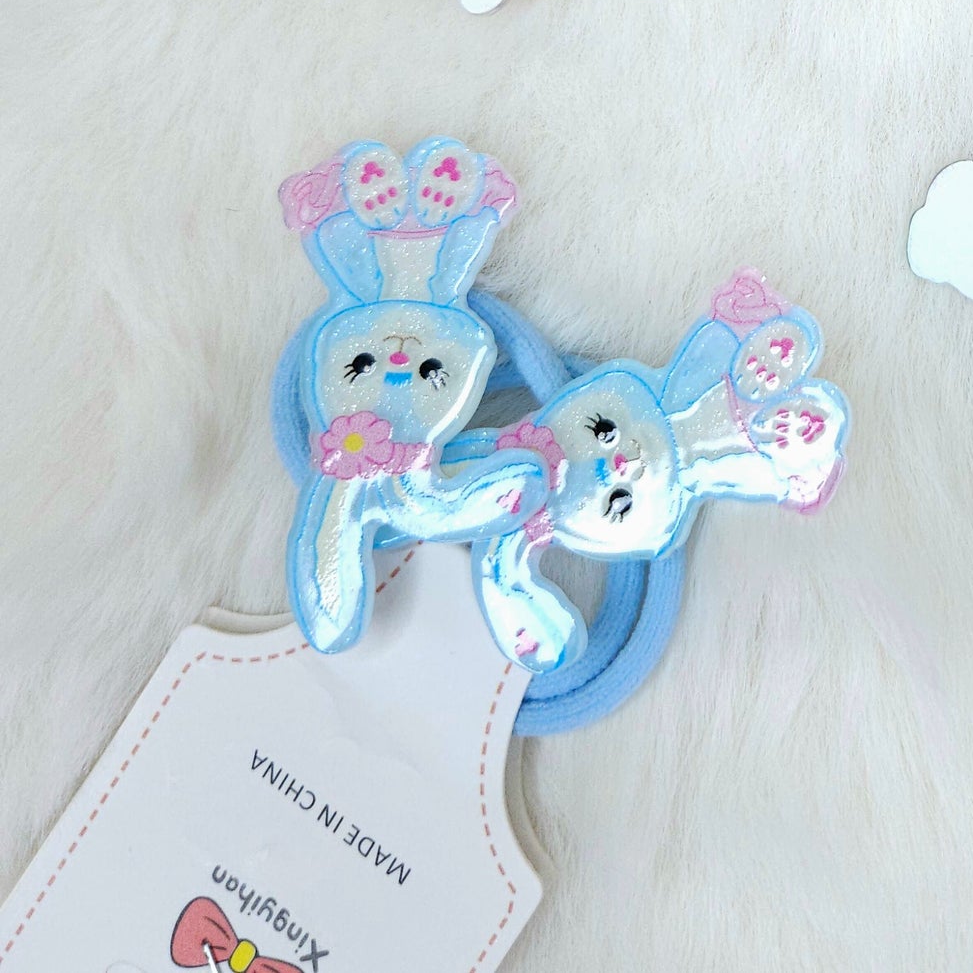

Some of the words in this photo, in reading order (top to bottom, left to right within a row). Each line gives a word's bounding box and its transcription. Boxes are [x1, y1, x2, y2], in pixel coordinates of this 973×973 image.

[250, 749, 316, 811] CHINA
[316, 803, 344, 834] IN
[343, 824, 412, 886] MADE
[211, 864, 330, 973] Xingyihan
